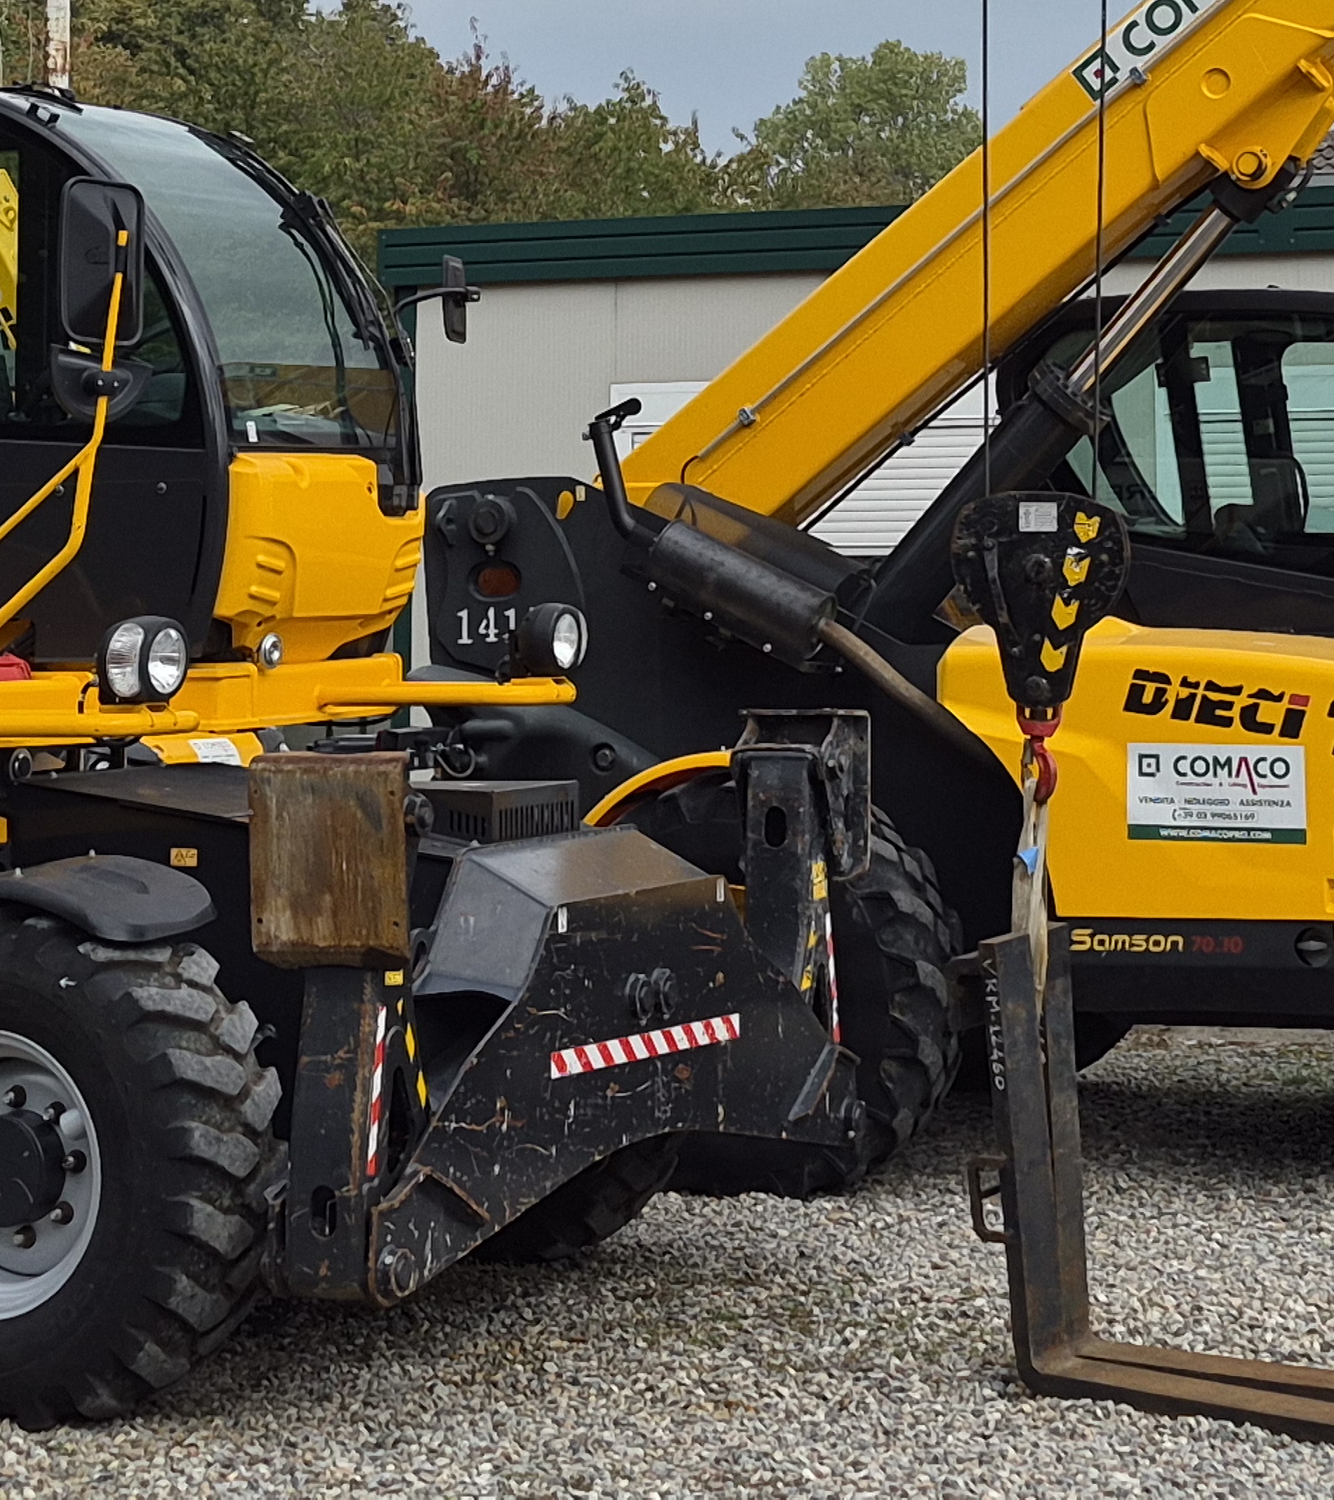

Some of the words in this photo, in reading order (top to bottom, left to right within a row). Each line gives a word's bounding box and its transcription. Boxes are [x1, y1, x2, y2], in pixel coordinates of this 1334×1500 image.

[456, 606, 536, 645] 141
[1173, 755, 1291, 795] COMACO
[1069, 928, 1184, 953] Samson
